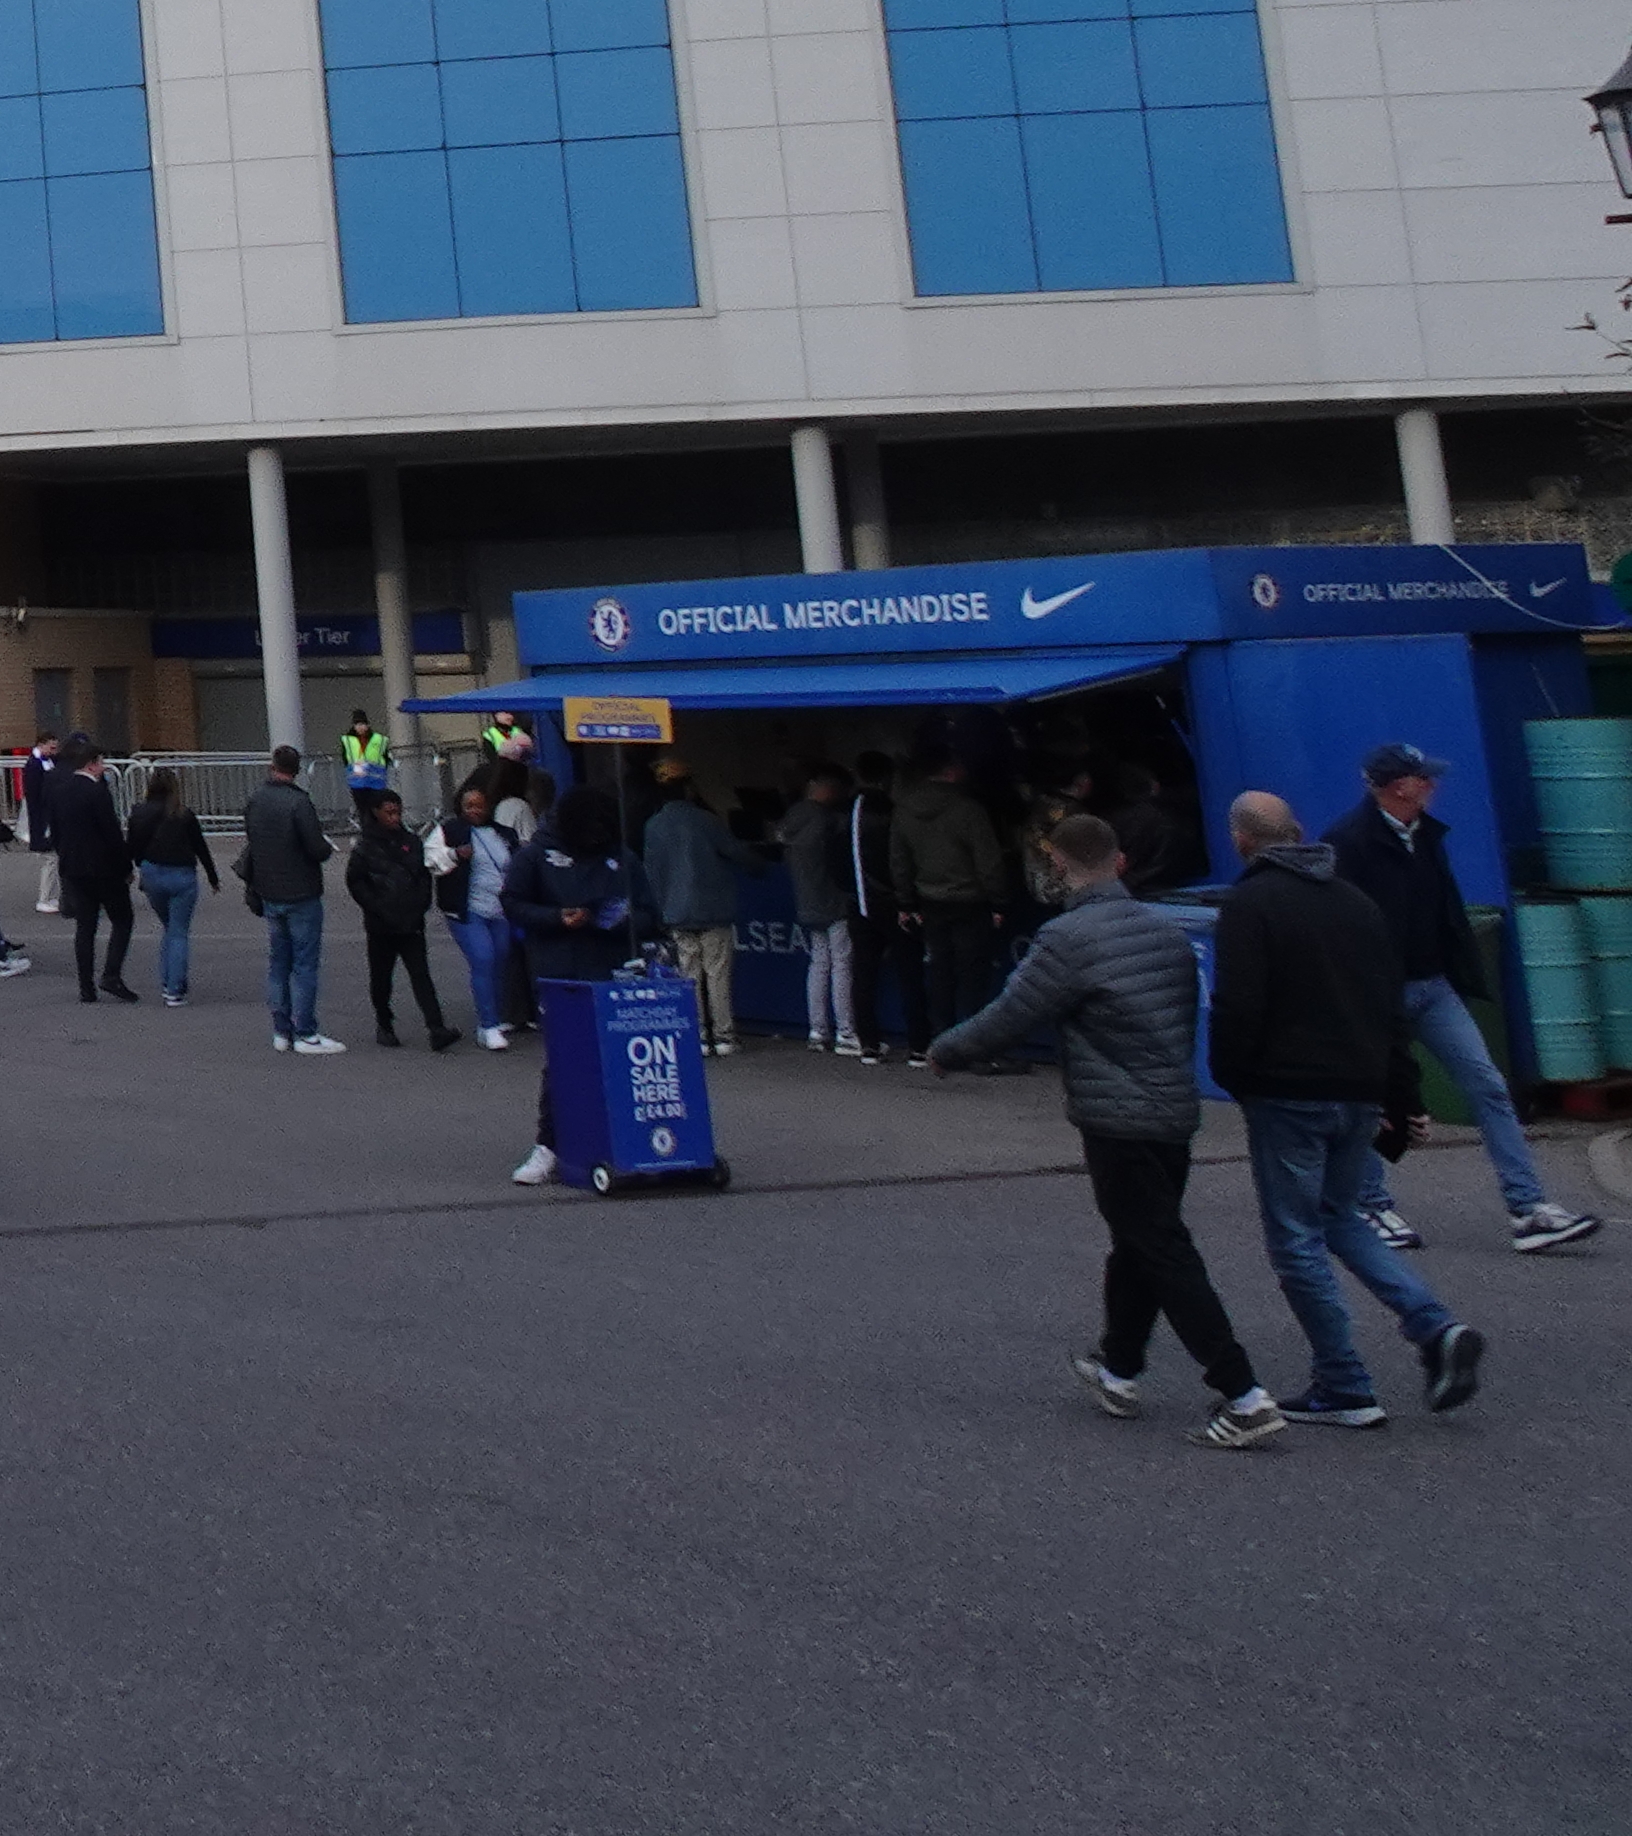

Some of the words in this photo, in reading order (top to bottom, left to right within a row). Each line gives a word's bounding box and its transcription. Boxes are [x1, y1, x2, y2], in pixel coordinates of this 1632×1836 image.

[1303, 581, 1384, 603] OFFICIAL
[1388, 579, 1509, 601] MERCHANDISE
[658, 602, 778, 635] OFFICIAL
[784, 592, 990, 631] MERCHANDISE
[314, 627, 351, 645] Tier
[627, 1035, 677, 1065] ON
[630, 1065, 679, 1085] SALE
[633, 1084, 681, 1103] HERE
